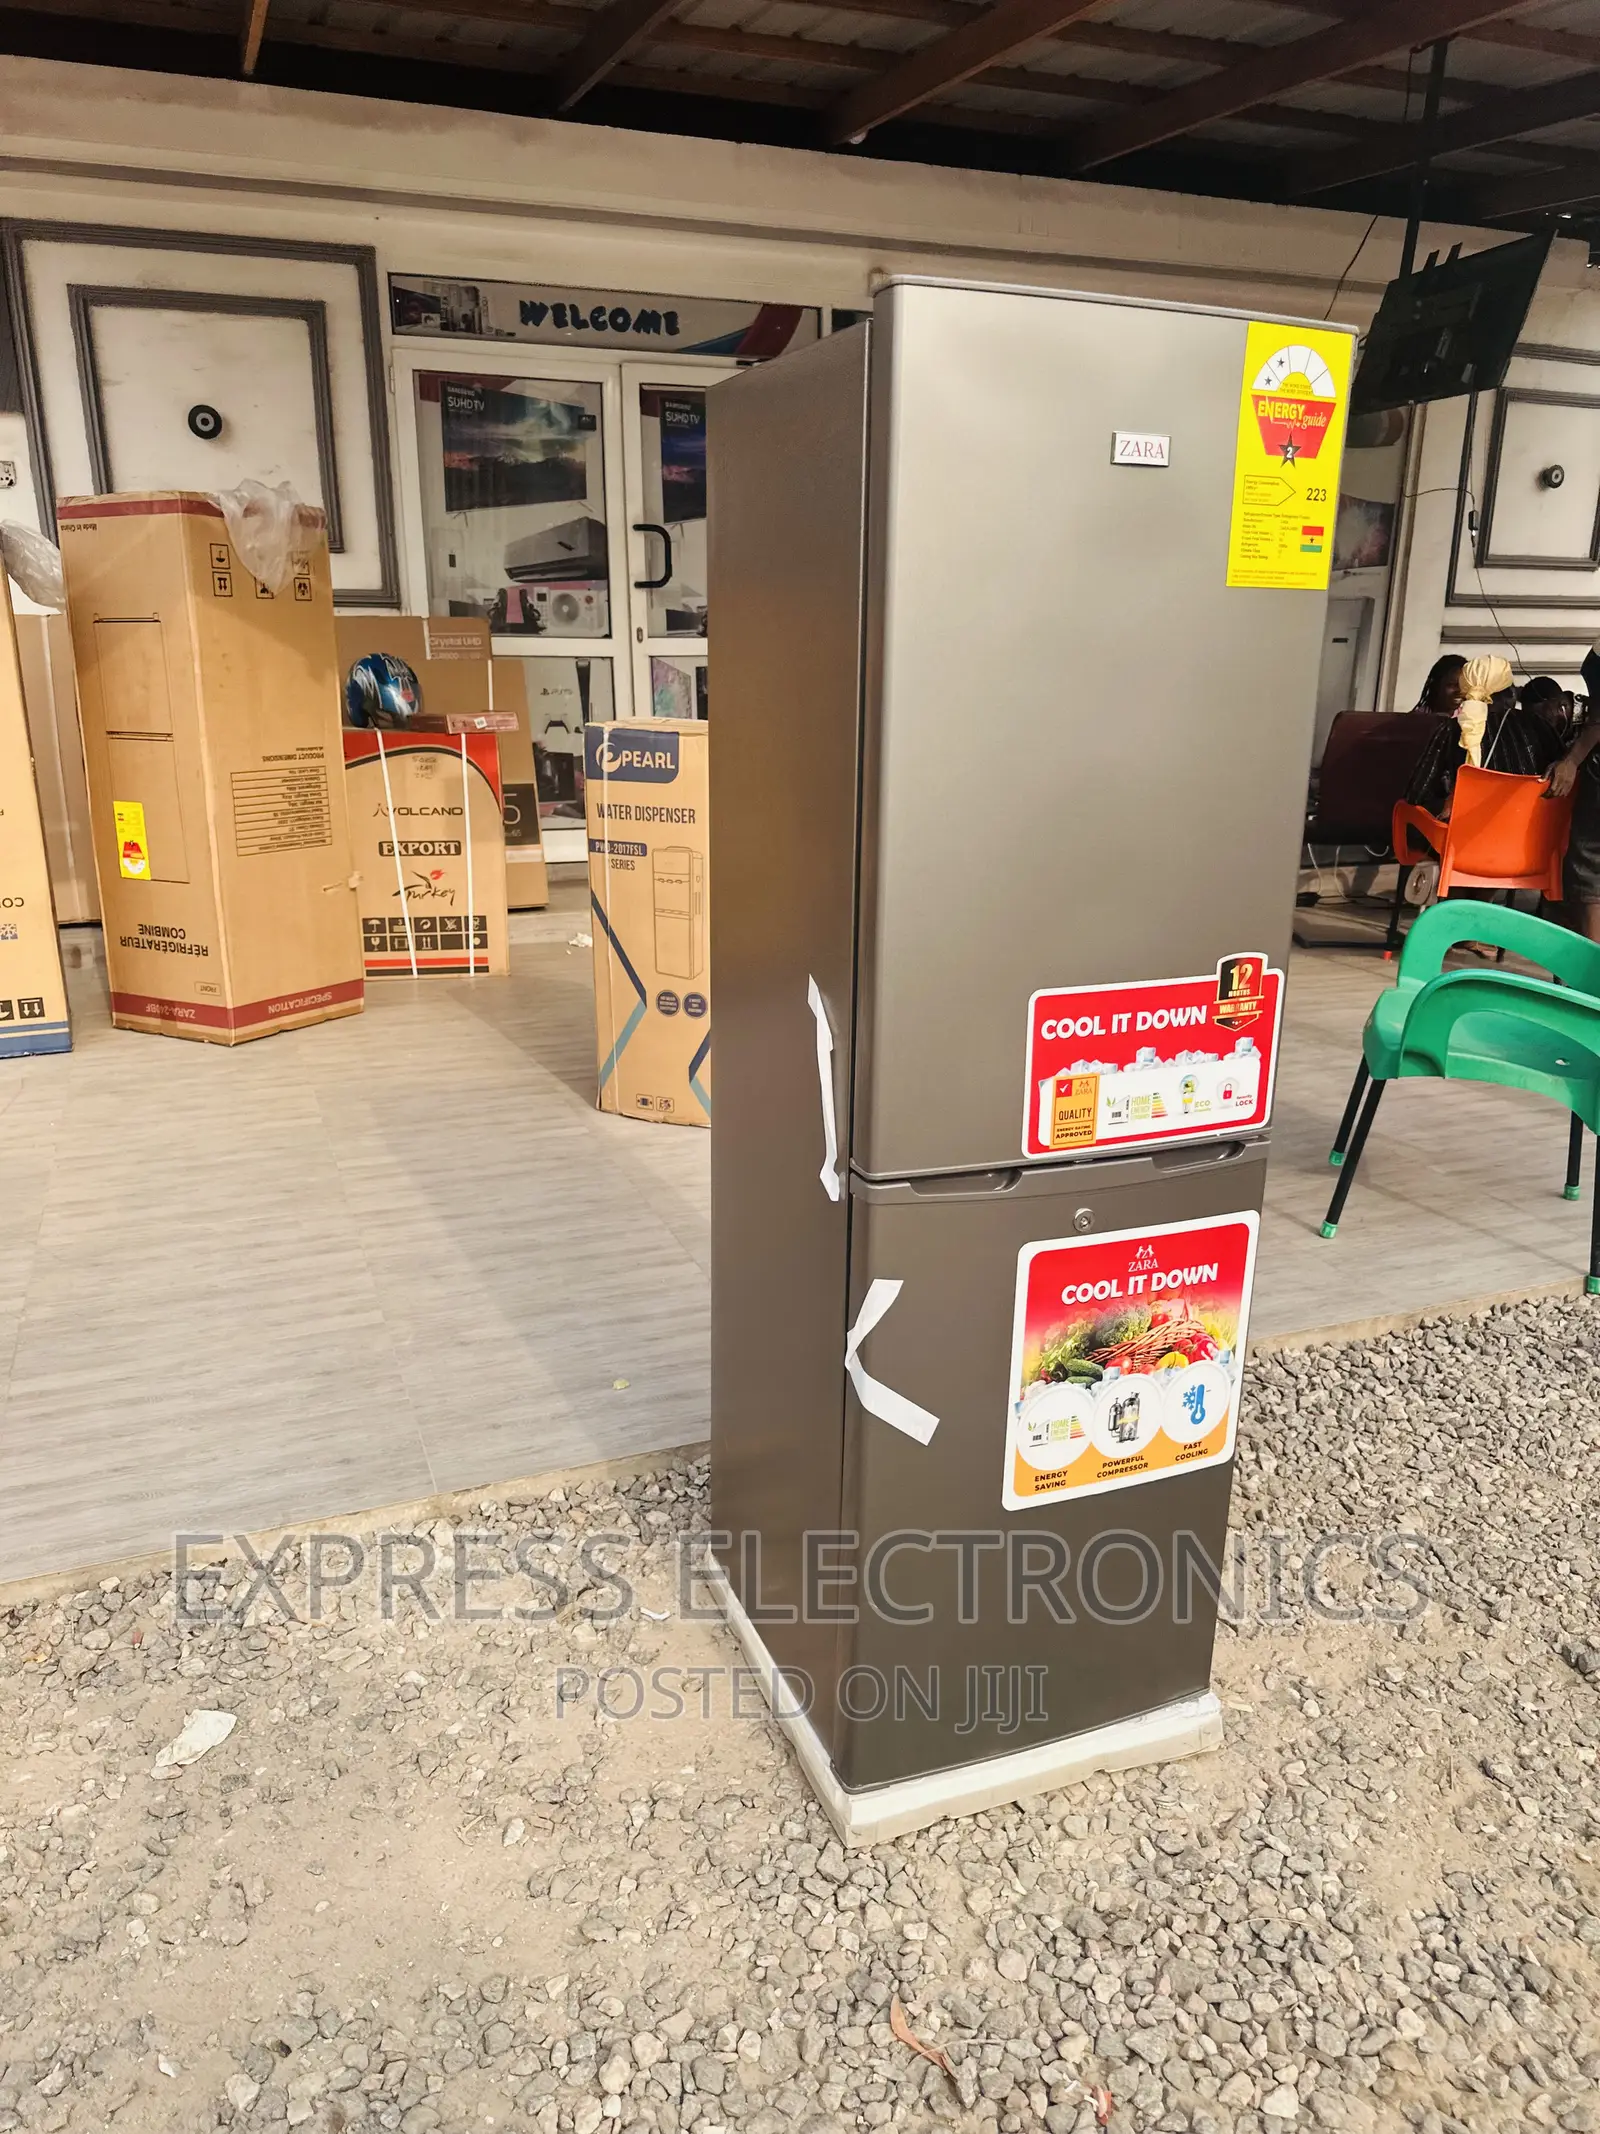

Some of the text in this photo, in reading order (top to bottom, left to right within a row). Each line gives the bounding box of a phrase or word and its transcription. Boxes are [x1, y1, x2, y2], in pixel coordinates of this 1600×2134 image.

[518, 299, 681, 336] WELCOME
[1257, 397, 1327, 430] ENERGY guide
[1119, 439, 1165, 460] ZARA
[1286, 446, 1293, 459] 2
[1306, 487, 1327, 502] 223
[621, 750, 676, 770] PEARL
[635, 804, 696, 824] DISPENSER
[381, 841, 460, 856] EXPORT
[610, 858, 636, 871] SERIES
[394, 884, 457, 907] Turkey
[137, 923, 186, 940] COMBINE
[120, 936, 209, 958] RÉFRIGÉRATEUR
[1230, 963, 1253, 991] 12
[200, 984, 217, 993] FRONT
[267, 991, 332, 1015] SPECIFICATION
[1219, 1001, 1257, 1015] WARRANTY
[1041, 1005, 1207, 1041] COOL IT DOWN
[1131, 1095, 1151, 1107] HOME
[1194, 1099, 1211, 1108] ECO
[1235, 1099, 1254, 1107] LOCK
[1058, 1107, 1093, 1121] QUALITY
[1055, 1129, 1093, 1140] APPROVED
[1127, 1258, 1159, 1273] ZARA
[1061, 1262, 1219, 1306] COOL IT DOWN
[1183, 1441, 1203, 1452] FAST
[1101, 1454, 1145, 1469] POWERFUL
[1174, 1448, 1209, 1462] COOLING
[1034, 1470, 1068, 1483] ENERGY
[1096, 1462, 1149, 1479] COMPRESSOR
[1034, 1479, 1067, 1492] SAVING
